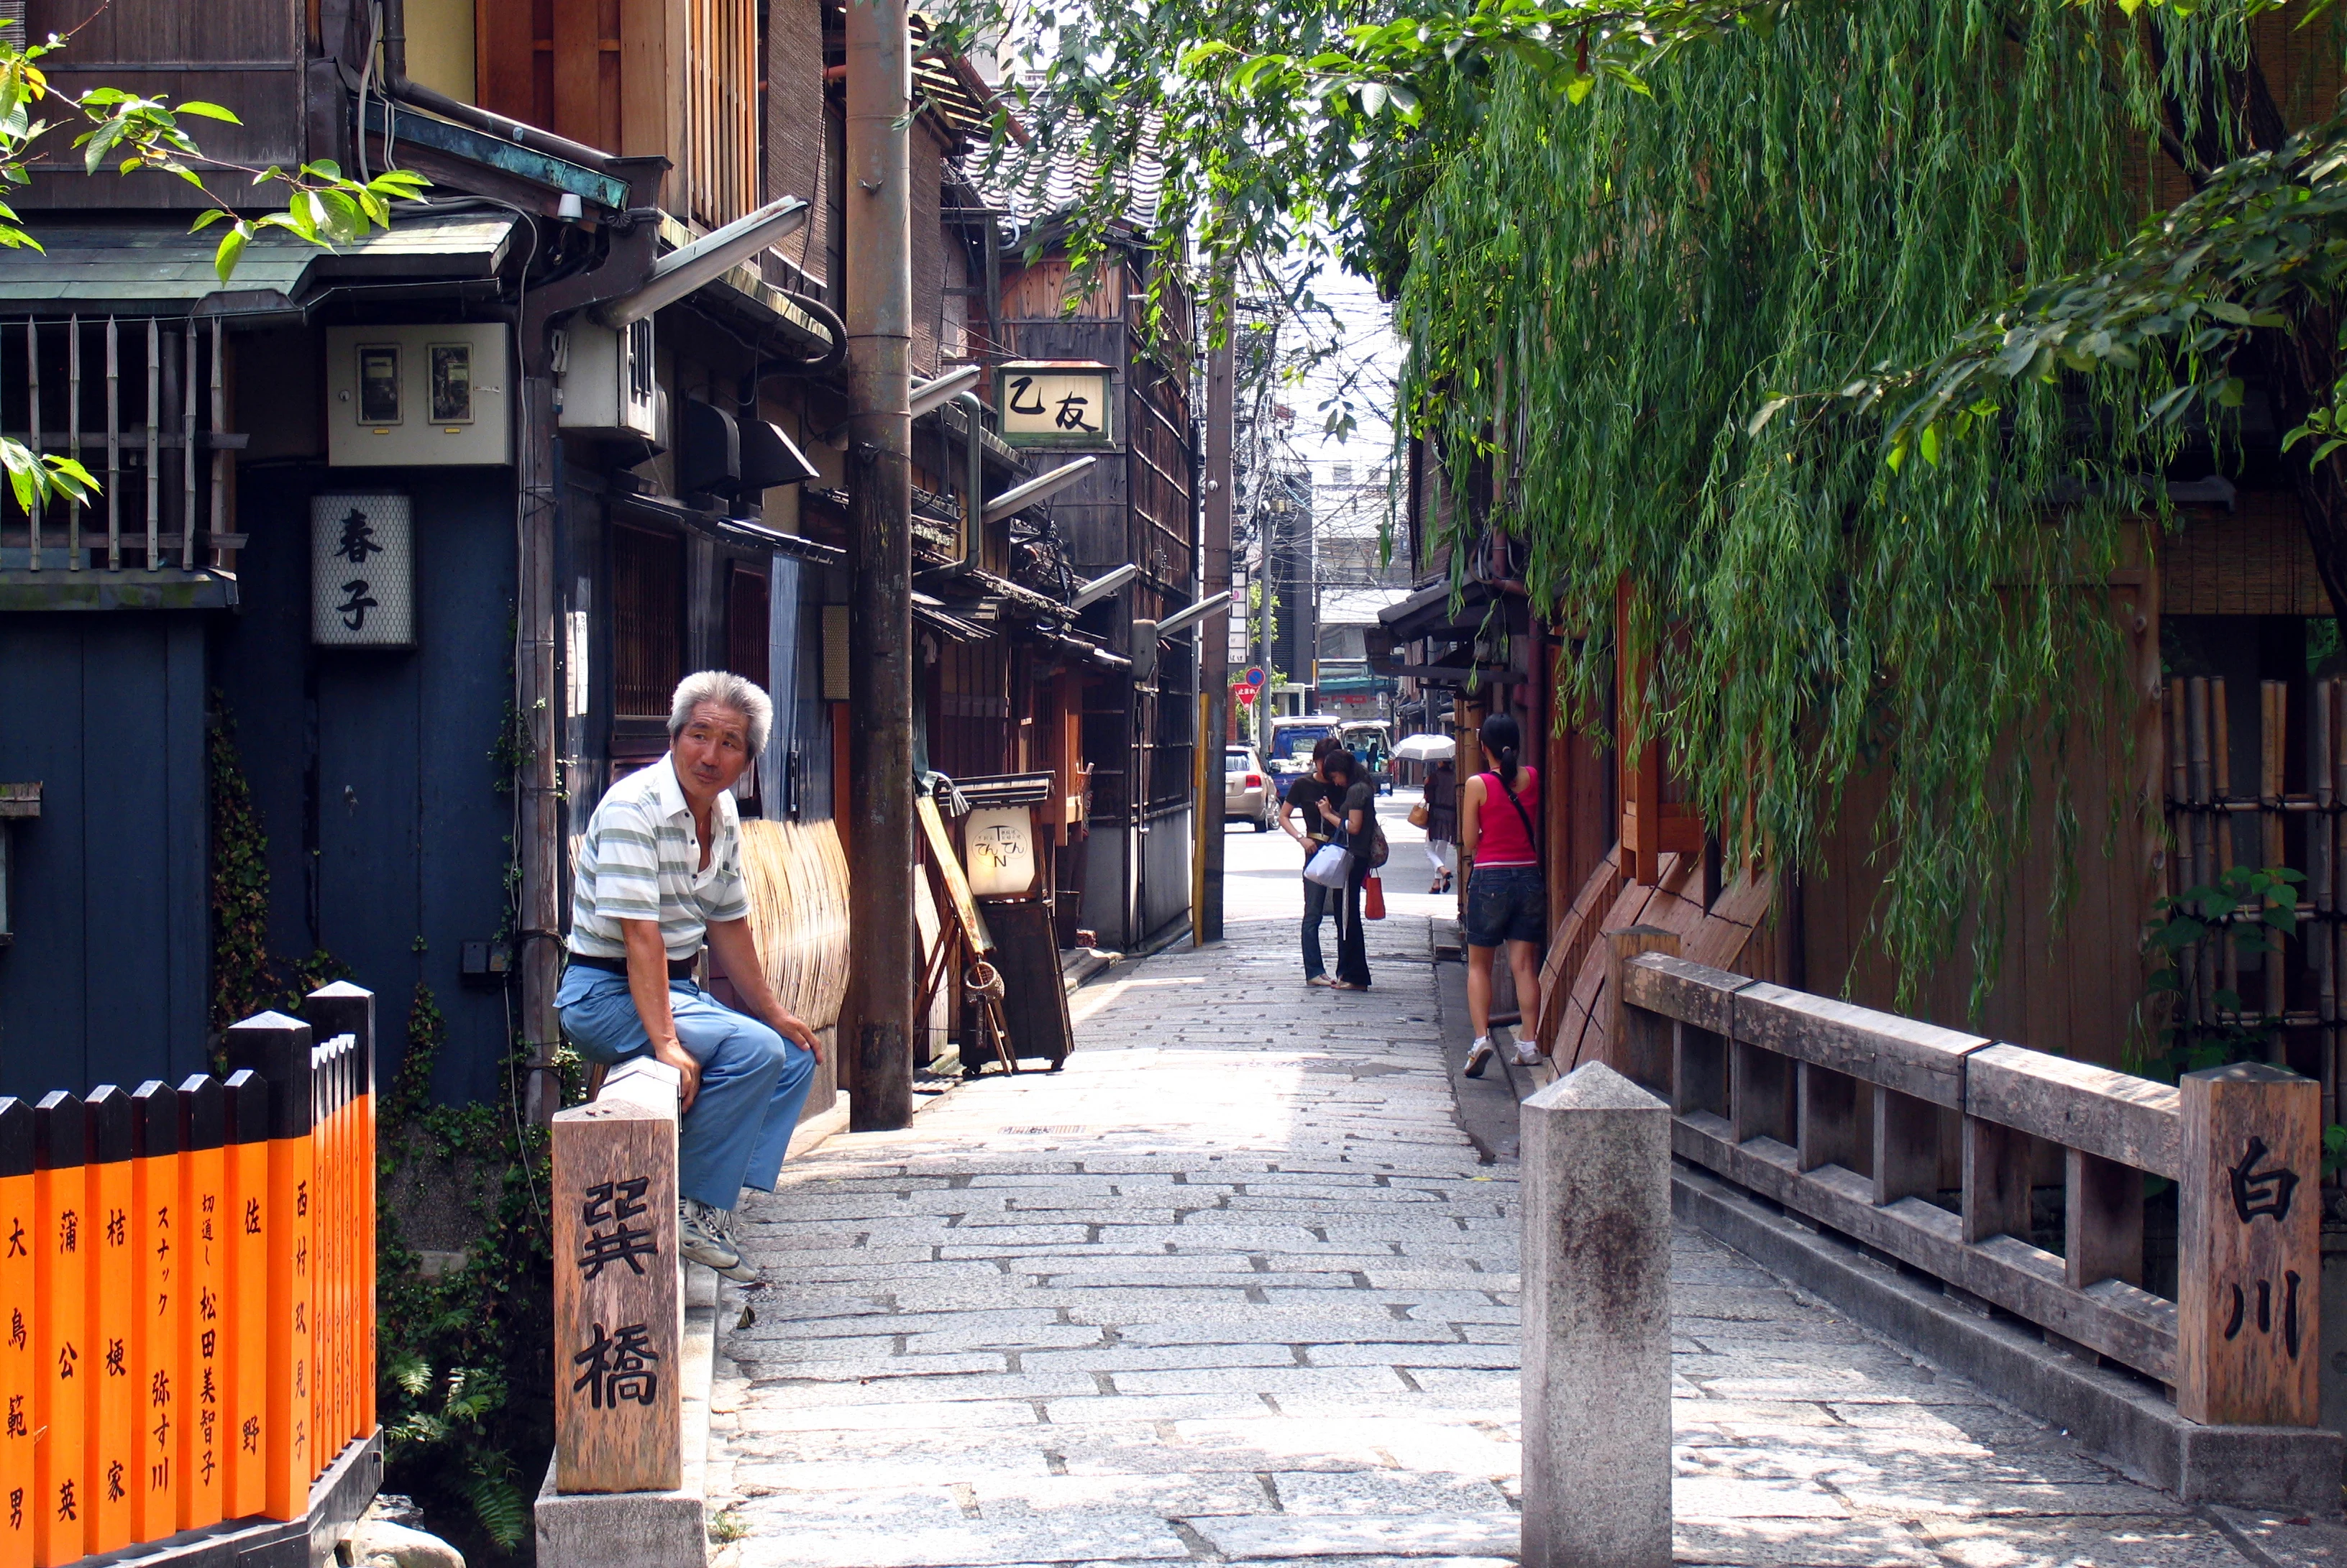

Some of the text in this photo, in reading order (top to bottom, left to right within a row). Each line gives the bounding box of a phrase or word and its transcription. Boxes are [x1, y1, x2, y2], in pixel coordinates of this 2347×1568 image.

[1009, 377, 1099, 432] 乙友
[334, 508, 383, 631] 春子
[975, 842, 1025, 856] てん てん
[994, 856, 1007, 867] N
[58, 1209, 78, 1522] 蒲公英
[106, 1209, 126, 1503] 桔梗家
[152, 1206, 170, 1496] スナック 弥す川
[200, 1194, 216, 1487] 切通し 松田美智子
[242, 1197, 261, 1455] 佐野
[575, 1176, 659, 1409] 巽橋
[2225, 1135, 2301, 1360] 白川
[7, 1217, 27, 1531] 大鳥範男
